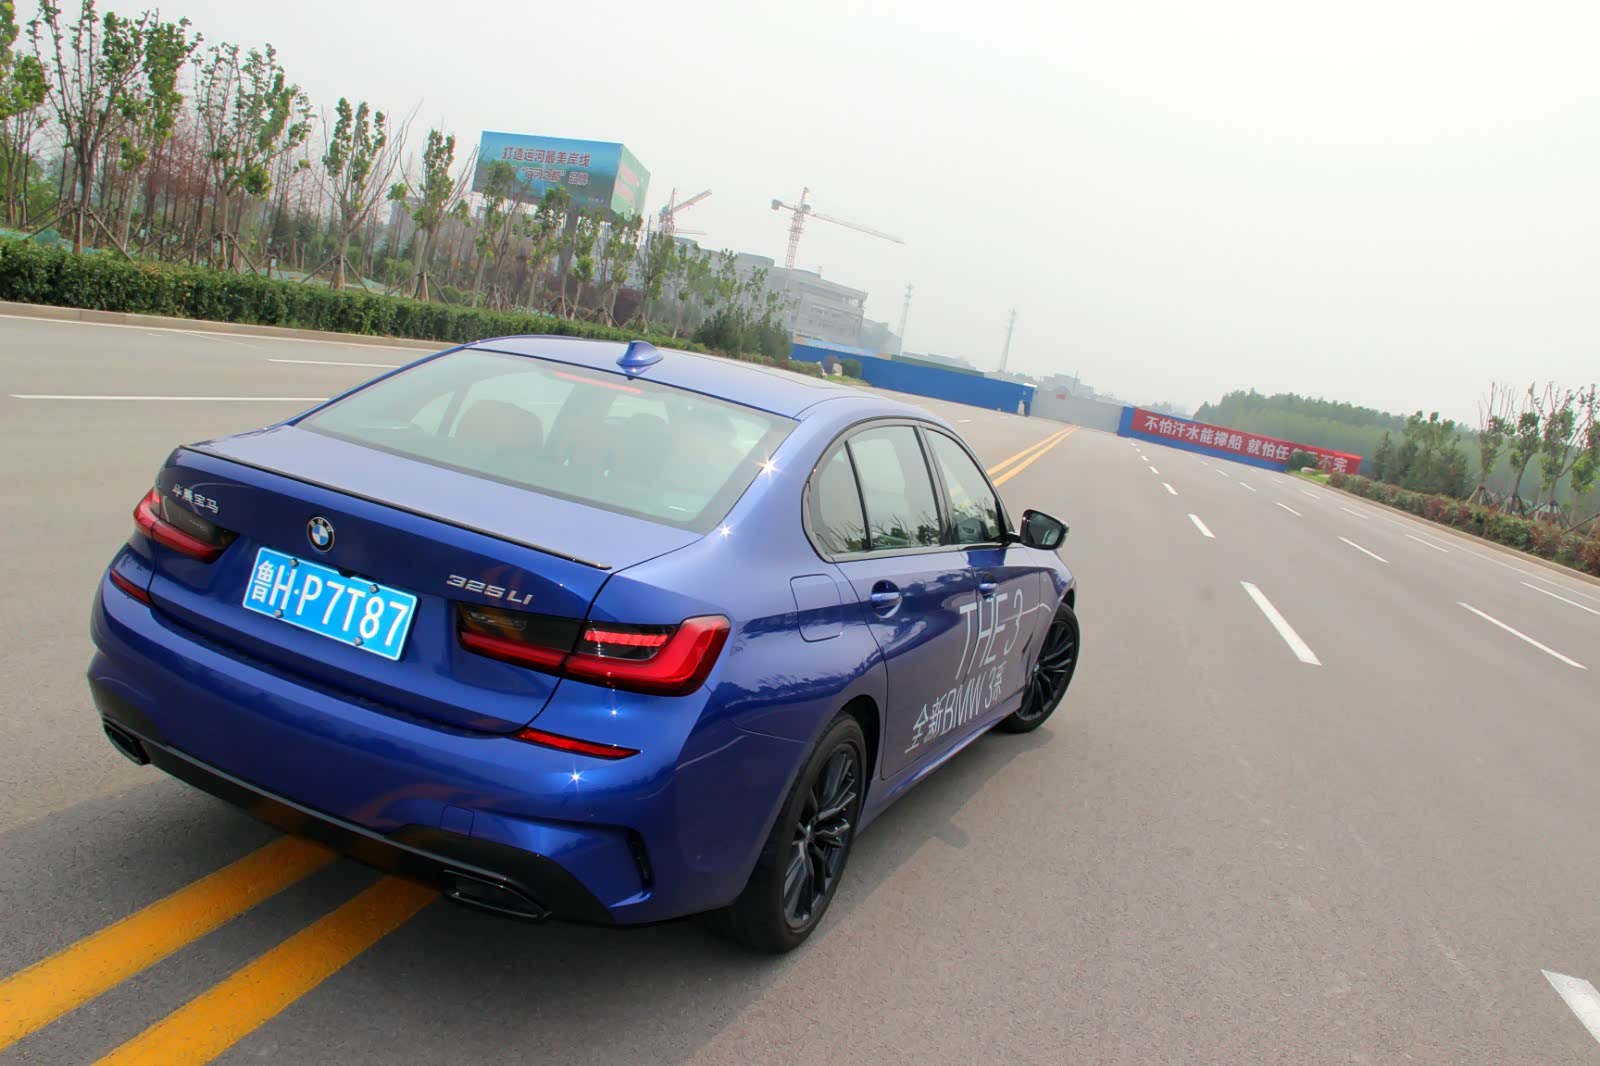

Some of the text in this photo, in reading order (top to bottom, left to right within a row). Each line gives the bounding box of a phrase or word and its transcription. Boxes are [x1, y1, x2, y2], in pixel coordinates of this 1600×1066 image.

[502, 145, 591, 168] 打造运河最美岸线
[1144, 415, 1348, 473] 不怕汗水能撑船 就怕任不完
[172, 483, 219, 514] 华晨宝马
[308, 518, 334, 532] BMW
[955, 588, 1023, 681] THE 3
